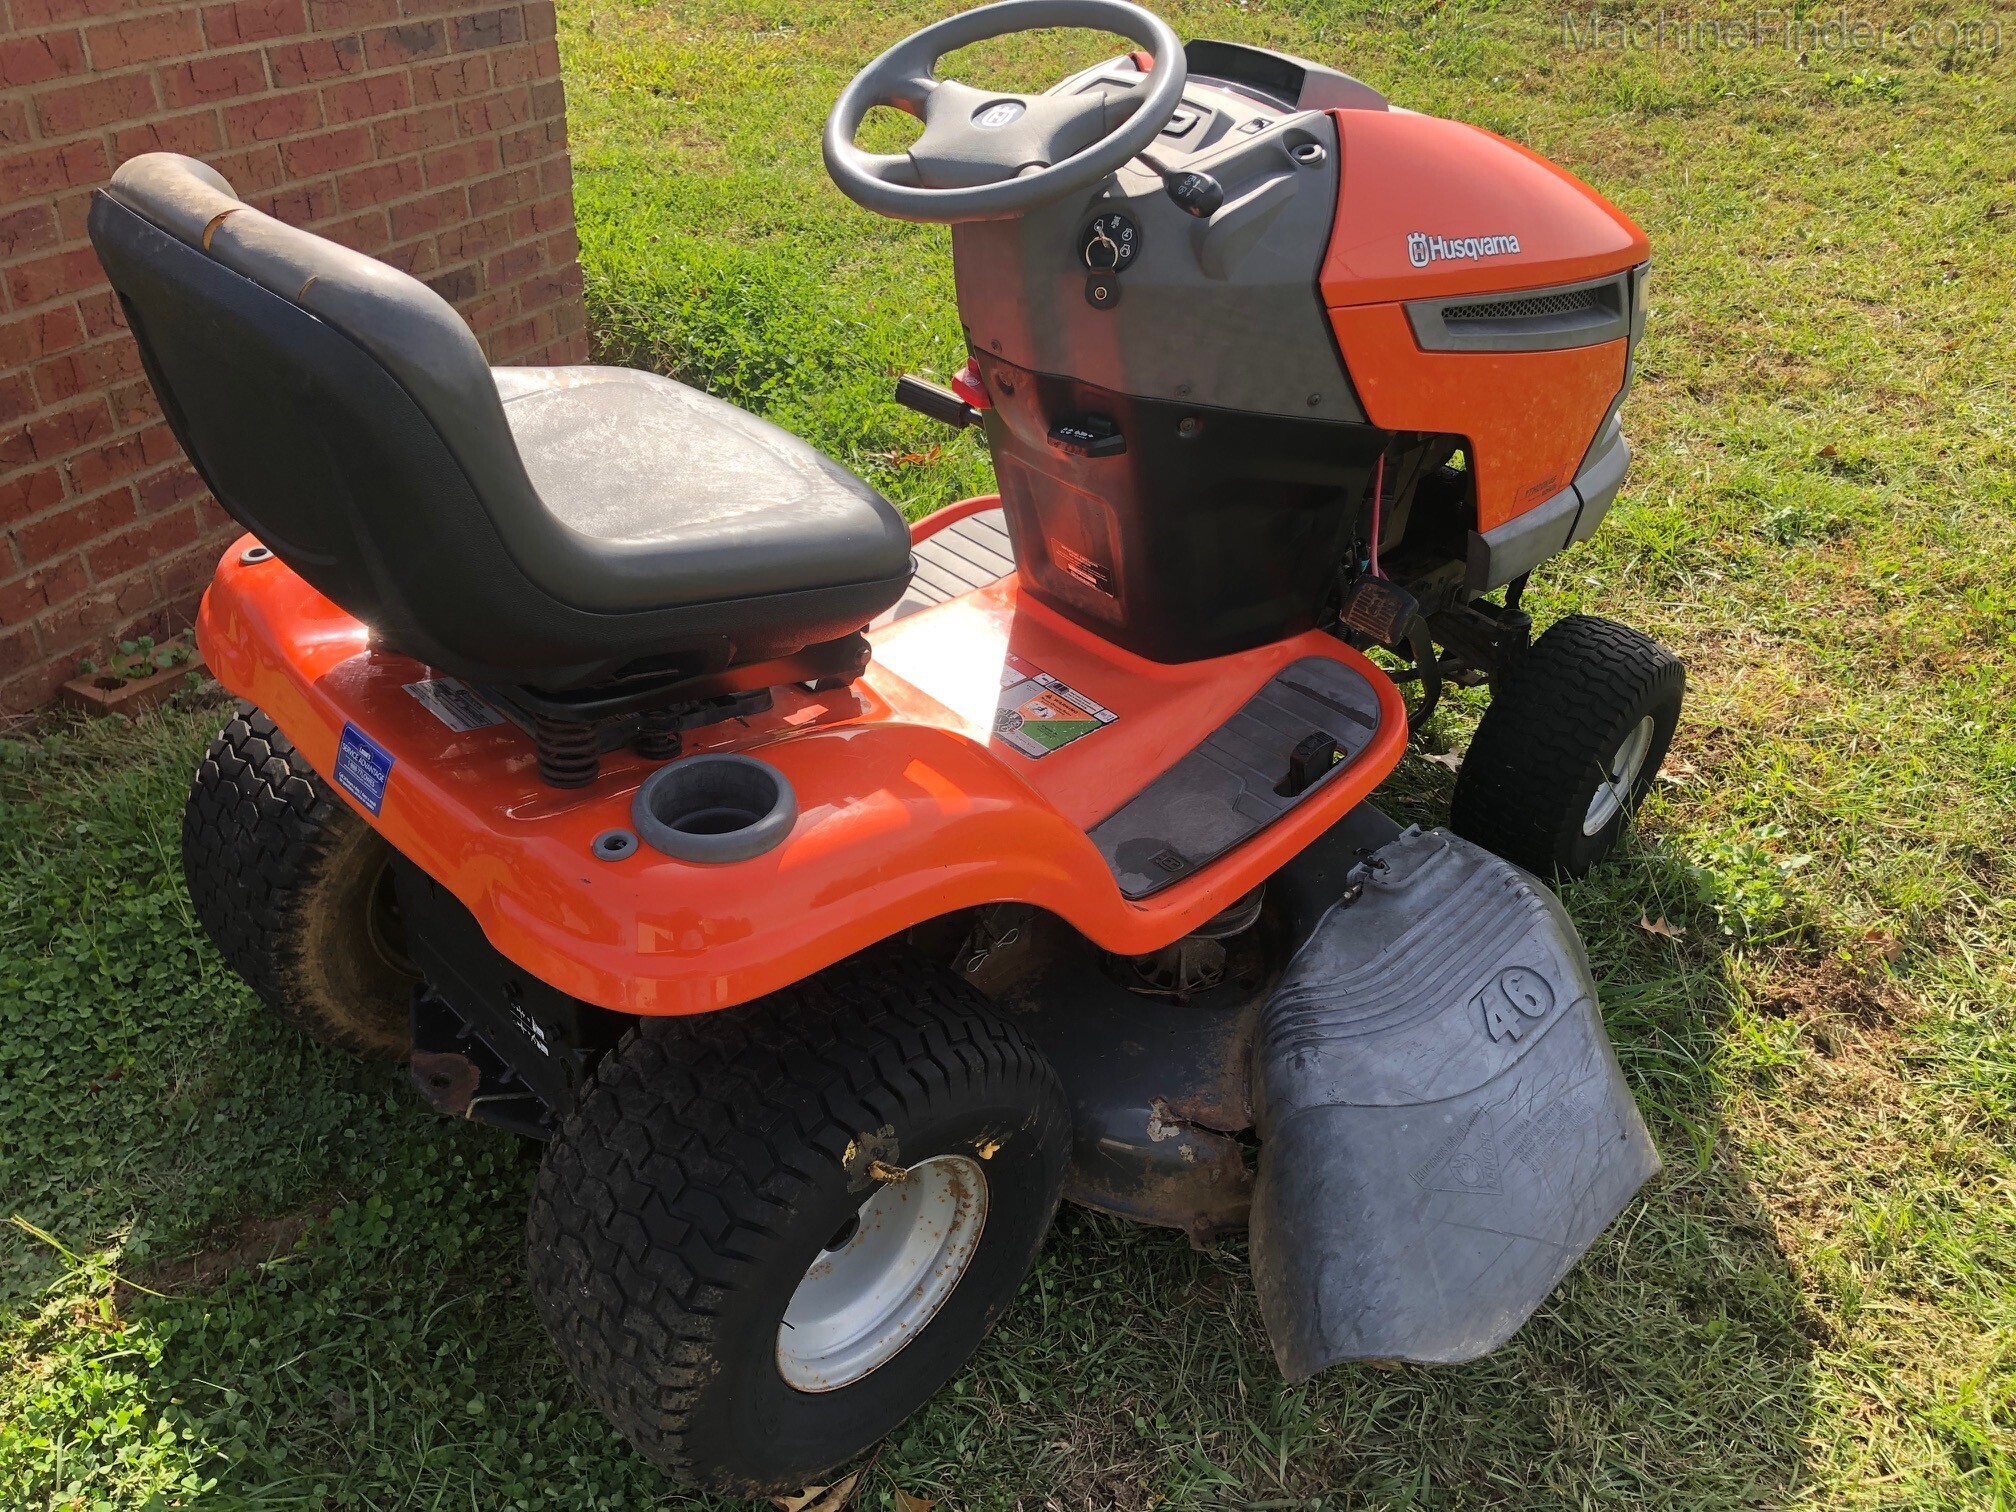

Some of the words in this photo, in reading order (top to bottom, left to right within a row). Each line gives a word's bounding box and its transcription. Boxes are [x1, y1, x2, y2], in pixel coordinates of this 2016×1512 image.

[1427, 234, 1521, 261] Husqvarna
[342, 743, 359, 761] SERVICE
[358, 757, 385, 783] ADVANTAGE
[1481, 969, 1547, 1043] 46
